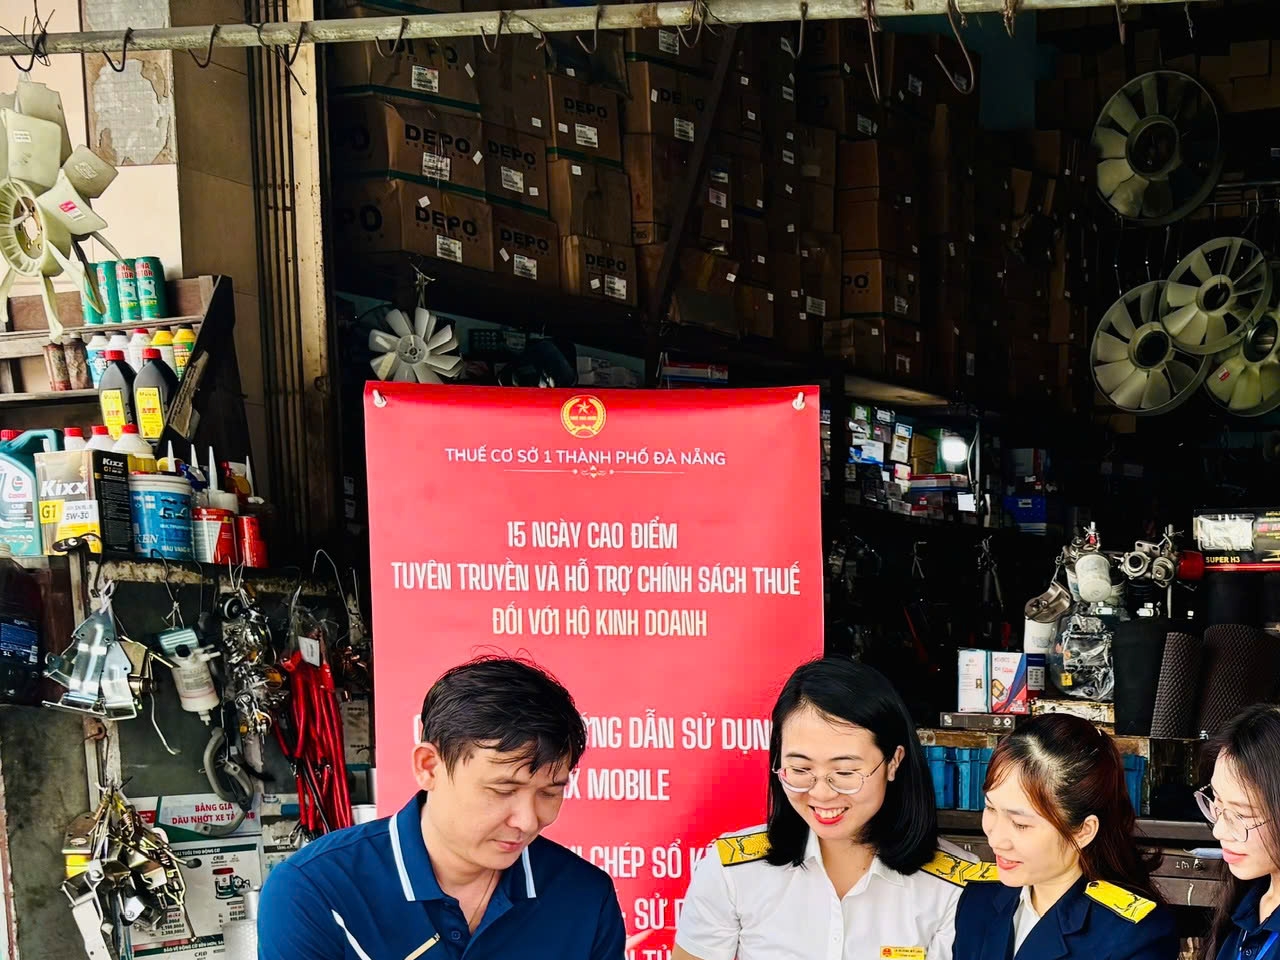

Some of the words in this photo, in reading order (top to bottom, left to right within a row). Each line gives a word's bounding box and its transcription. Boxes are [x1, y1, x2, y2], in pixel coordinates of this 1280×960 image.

[564, 97, 608, 119] DEPO
[405, 124, 470, 154] DEPO
[488, 138, 536, 166] DEPO
[416, 205, 477, 236] DEPO
[500, 228, 549, 252] DEPO
[586, 252, 627, 272] DEPO
[103, 458, 124, 467] Kixx
[445, 444, 487, 463] THUẾ
[491, 447, 512, 463] CƠ
[517, 447, 541, 464] SỞ
[544, 450, 552, 464] 1
[555, 444, 611, 464] THÀNH
[616, 447, 650, 465] PHỐ
[653, 447, 677, 465] ĐÀ
[681, 446, 726, 466] NẴNG
[40, 480, 88, 497] Kixx
[41, 505, 56, 518] G1
[507, 521, 526, 548] 15
[532, 518, 581, 548] NGÀY
[587, 521, 624, 548] CAO
[630, 516, 678, 550] ĐIỂM
[629, 709, 674, 749] DẪN
[682, 712, 718, 749] SỬ
[722, 717, 772, 755] DỤN
[588, 768, 670, 800] MOBILE
[195, 802, 217, 812] BẢNG
[590, 842, 645, 878] CHÉP
[652, 839, 682, 879] SỔ
[634, 893, 668, 929] SỬ
